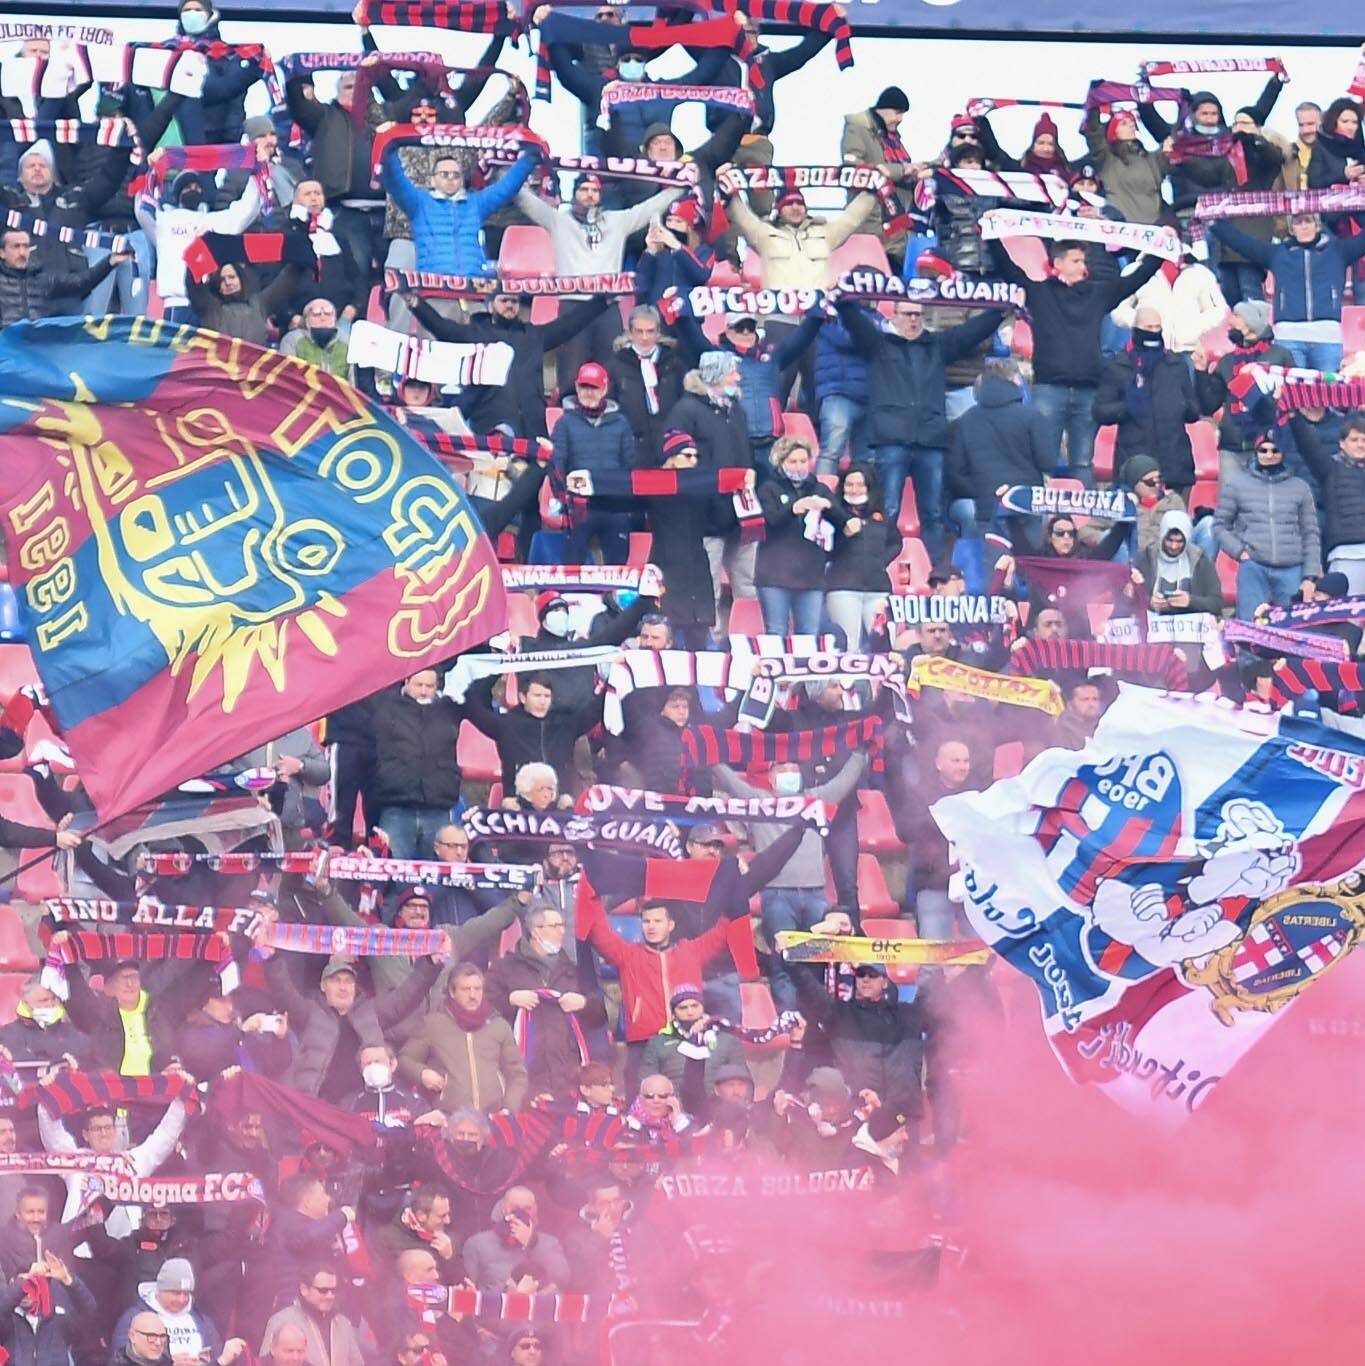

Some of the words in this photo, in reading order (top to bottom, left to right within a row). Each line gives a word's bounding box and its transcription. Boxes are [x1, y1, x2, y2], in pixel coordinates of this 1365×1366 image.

[503, 274, 635, 292] BOLOGNA
[1033, 486, 1126, 513] BOLOGNA
[890, 595, 989, 624] BOLOGNA
[686, 791, 828, 831] MERDA
[51, 899, 120, 922] FINO
[133, 900, 216, 929] ALLA
[104, 1176, 199, 1205] Bologna
[203, 1175, 250, 1199] F.C.
